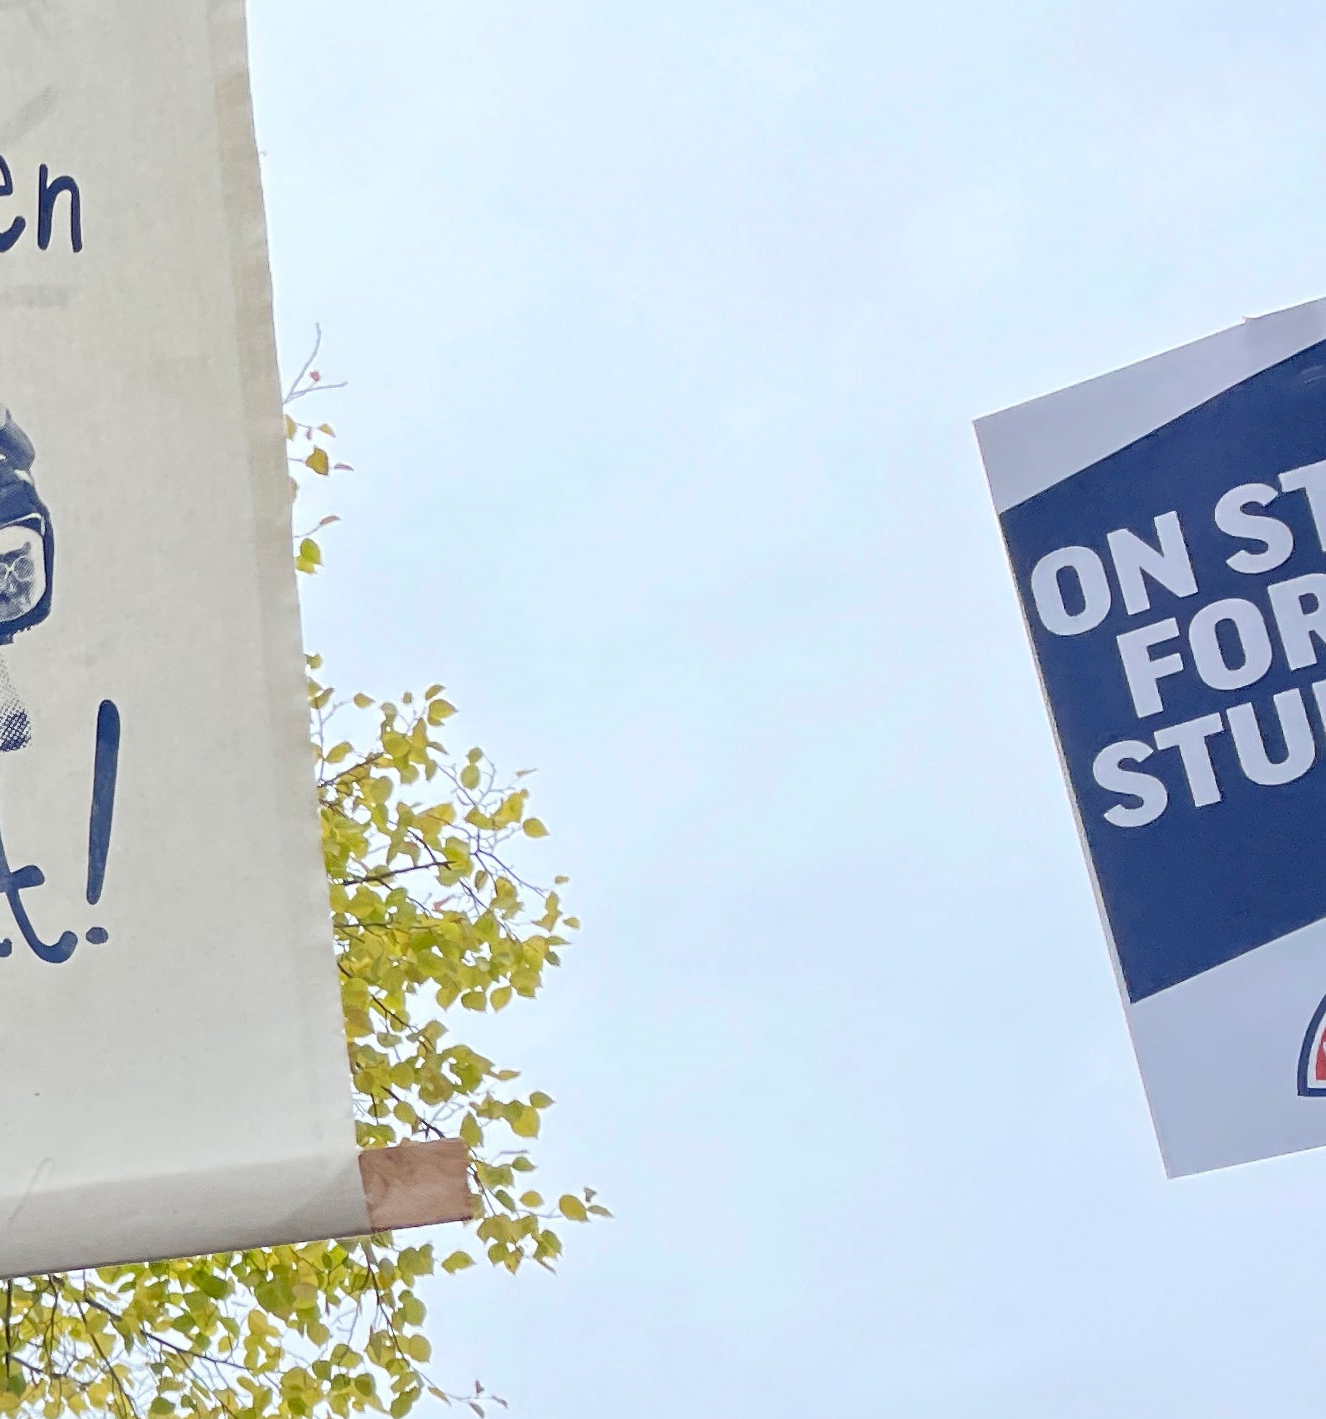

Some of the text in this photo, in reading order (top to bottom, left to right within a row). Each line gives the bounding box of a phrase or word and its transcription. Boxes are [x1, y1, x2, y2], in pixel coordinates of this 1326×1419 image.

[1030, 510, 1199, 637] ON
[1116, 572, 1326, 719] FOR
[1092, 679, 1326, 828] STU
